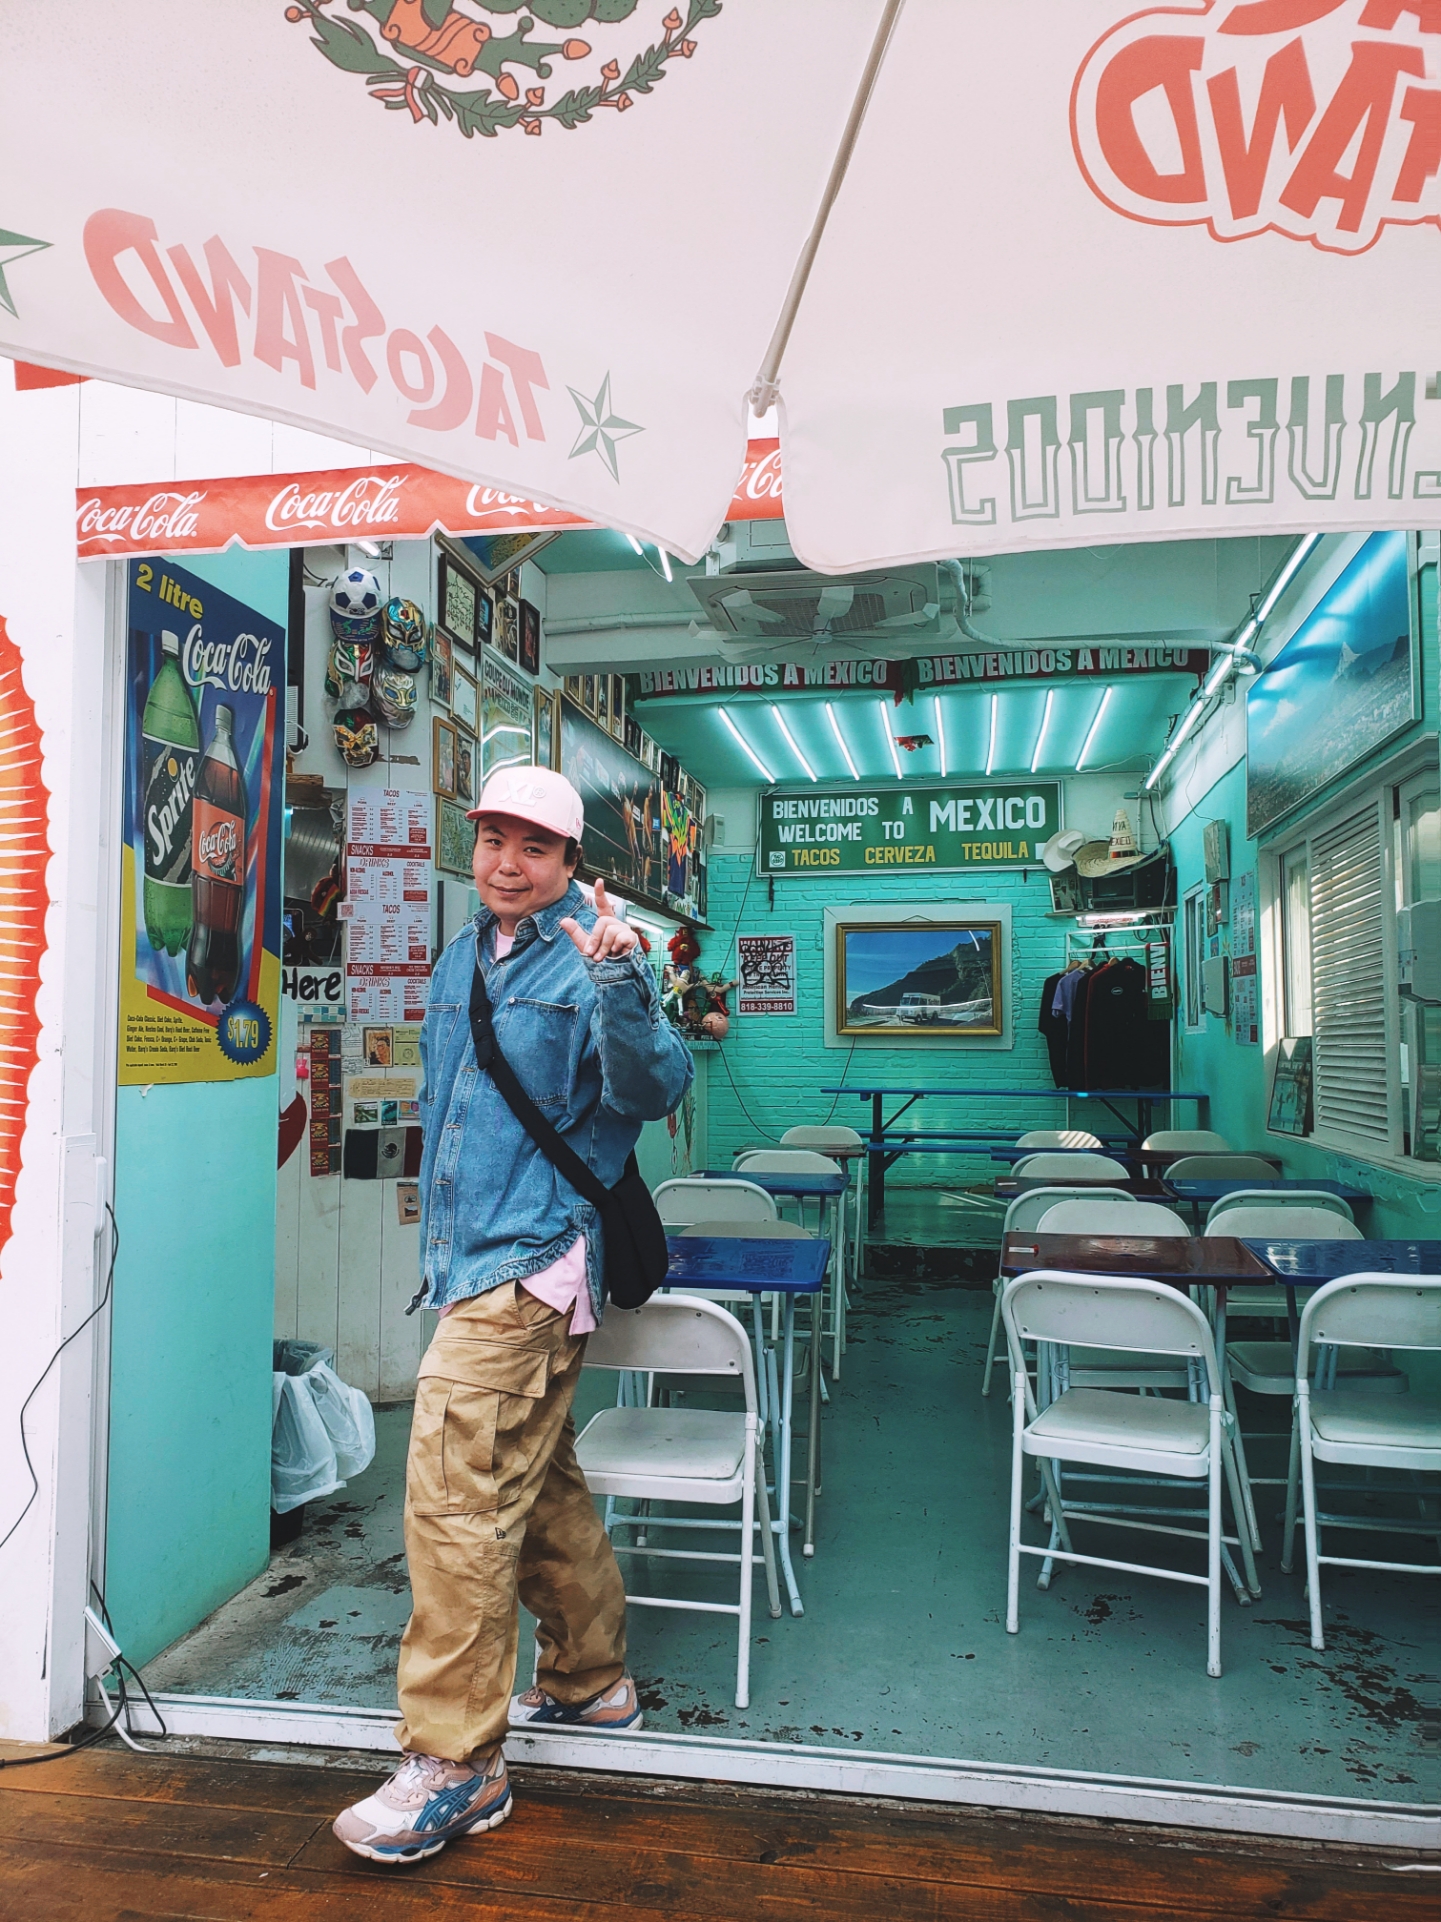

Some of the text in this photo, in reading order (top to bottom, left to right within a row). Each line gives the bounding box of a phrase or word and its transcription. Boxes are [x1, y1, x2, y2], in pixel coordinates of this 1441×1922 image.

[265, 475, 408, 532] Coca-Cola
[136, 563, 203, 619] 2 litre
[183, 624, 273, 696] Coca-Cola
[640, 660, 887, 693] BIENVENIDOS A MEXICO
[916, 648, 1189, 683] BIENVENIDOS A MEXICO
[383, 789, 400, 798] TACOS
[148, 756, 196, 866] Sprite
[772, 796, 1046, 833] BIENVENIDOS A MEXICO
[199, 820, 236, 863] Coca-Cola
[778, 821, 904, 843] WELCOME TO
[351, 845, 374, 856] SNACKS
[792, 848, 840, 866] TACOS
[864, 845, 936, 864] CERVEZA
[961, 841, 1029, 860] TEQUILA
[382, 904, 400, 914] TACOS
[282, 967, 341, 1001] Here
[351, 964, 374, 976] SNACKS
[359, 976, 390, 987] DRINKS
[740, 1002, 792, 1011] 818-339-8810
[227, 1015, 259, 1049] $1.79
